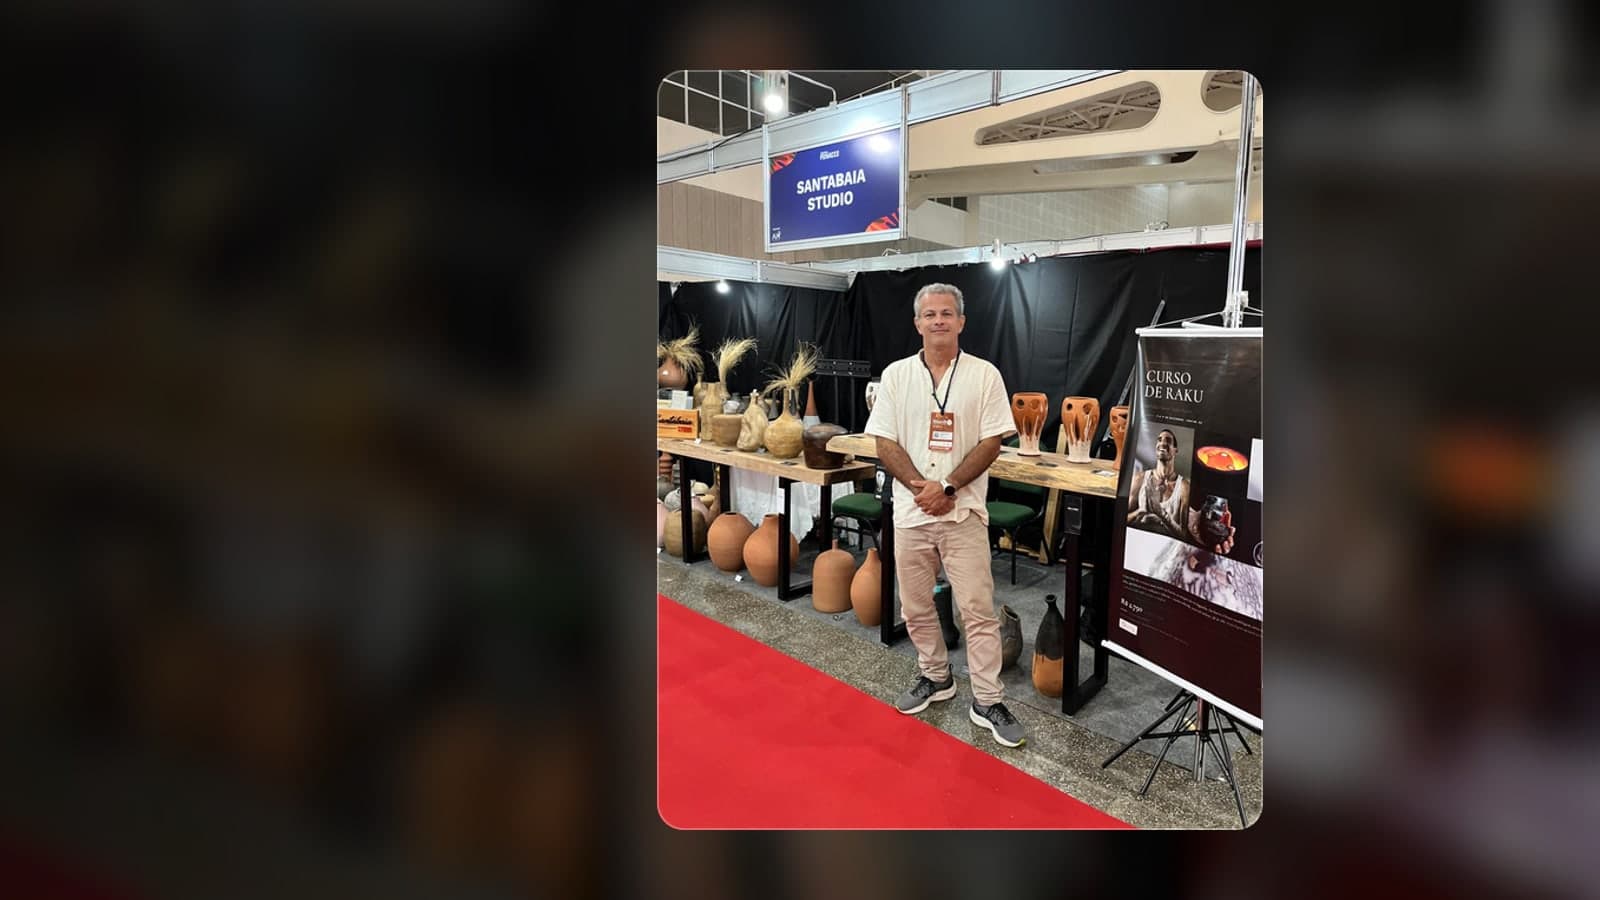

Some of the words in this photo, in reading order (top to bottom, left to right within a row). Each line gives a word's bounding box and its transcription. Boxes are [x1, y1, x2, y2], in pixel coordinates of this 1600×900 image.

[796, 168, 867, 195] SANTABAIA
[807, 190, 854, 211] STUDIO
[1146, 369, 1192, 386] CURSO
[1144, 384, 1163, 399] DE
[1166, 386, 1204, 404] RAKU
